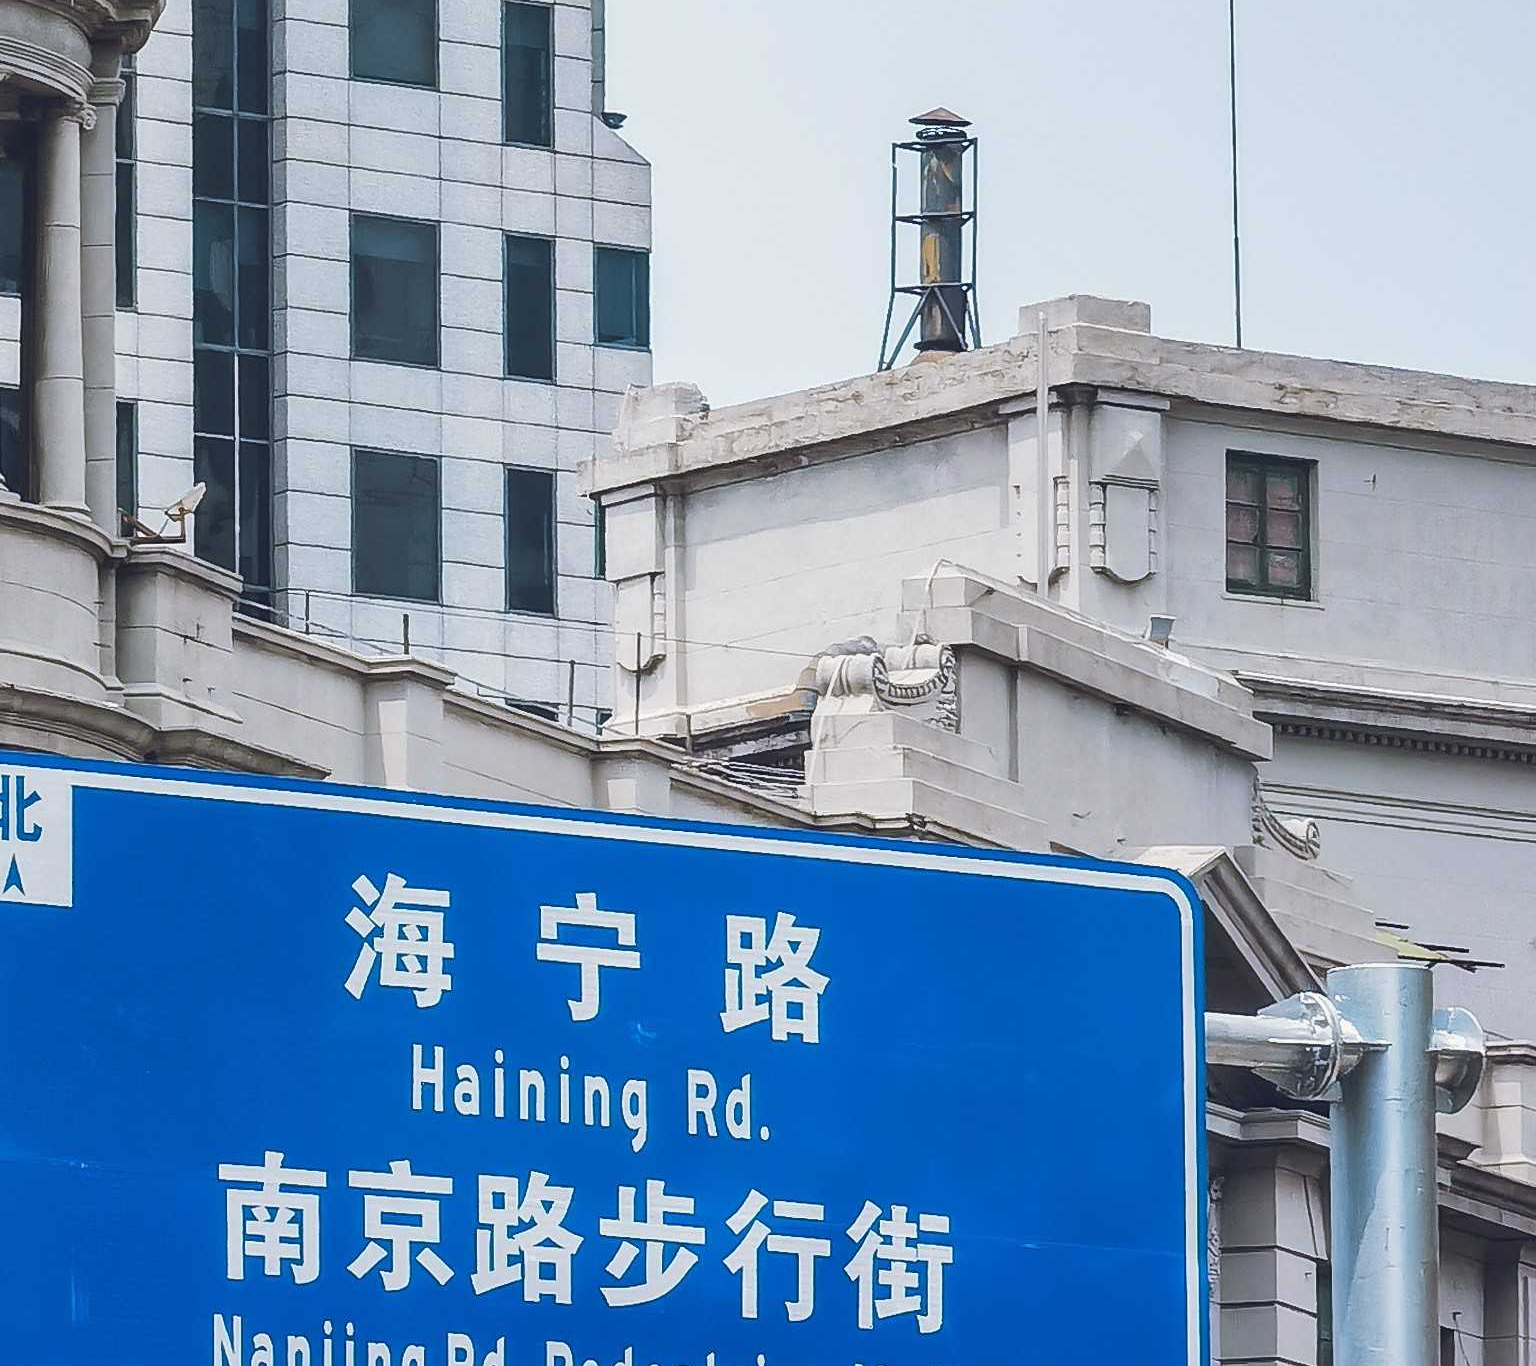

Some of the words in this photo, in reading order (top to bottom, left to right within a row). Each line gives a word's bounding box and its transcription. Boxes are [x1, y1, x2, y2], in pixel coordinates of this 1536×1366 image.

[344, 871, 831, 1045] 海宁路
[412, 1044, 648, 1152] Haining
[687, 1069, 771, 1142] Rd.
[216, 1151, 955, 1336] 南京路步行街
